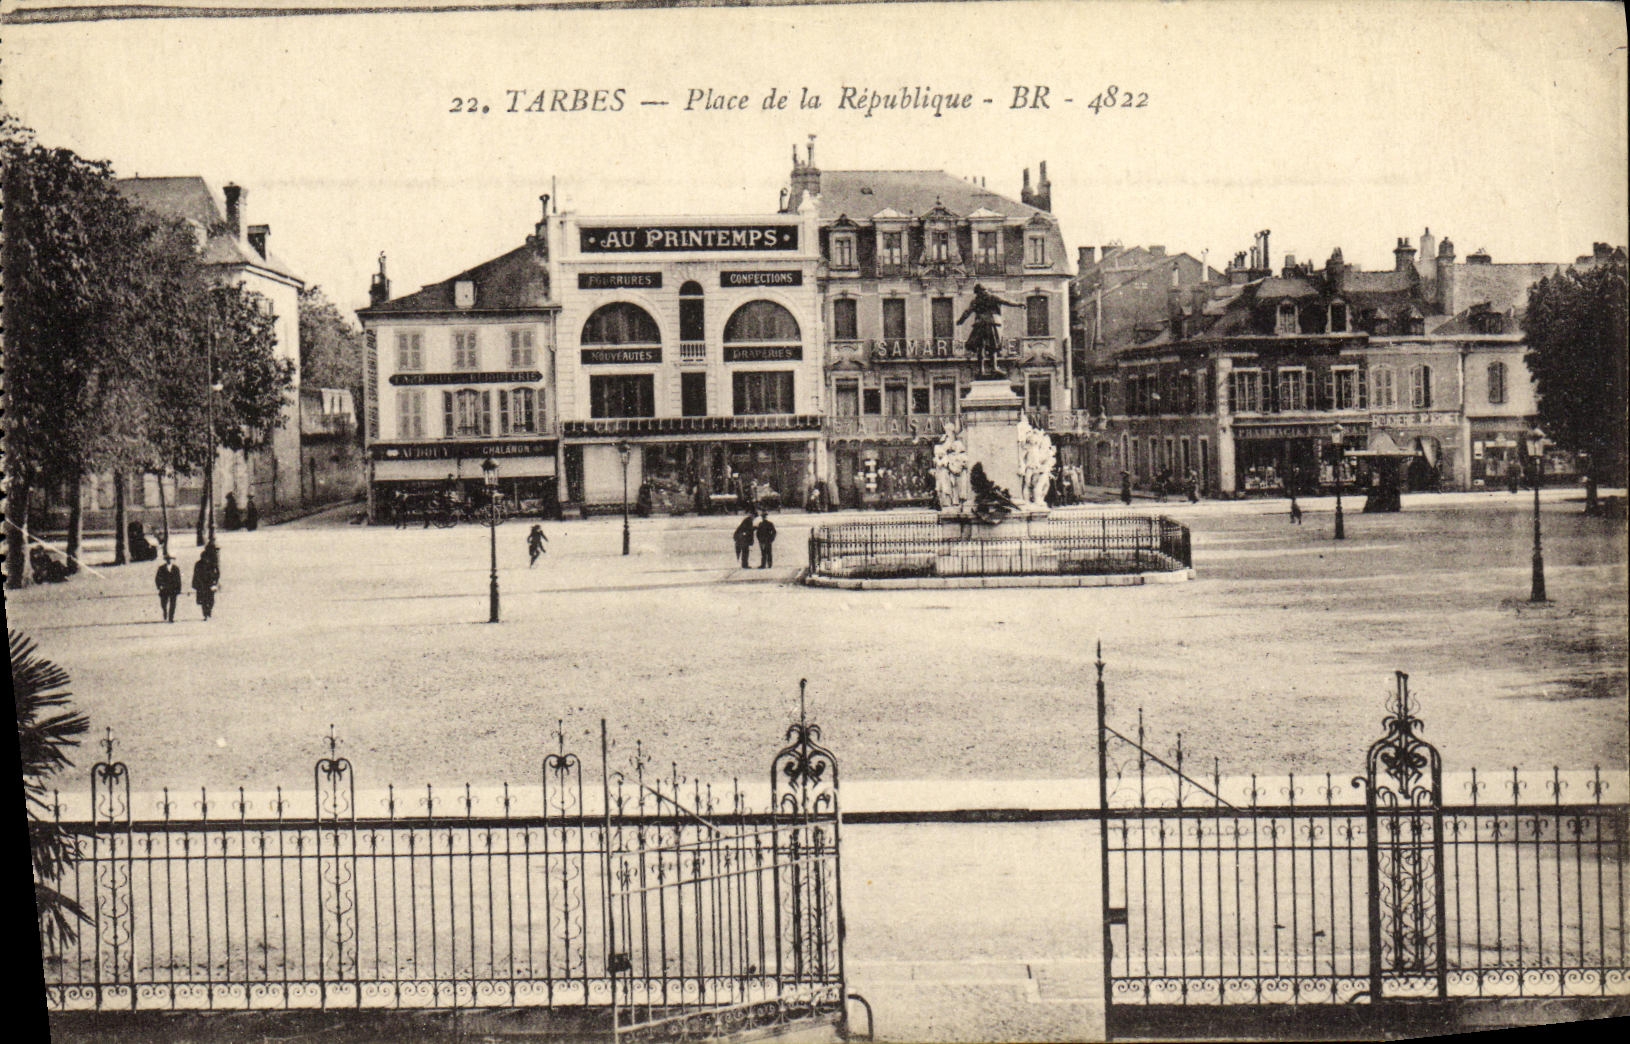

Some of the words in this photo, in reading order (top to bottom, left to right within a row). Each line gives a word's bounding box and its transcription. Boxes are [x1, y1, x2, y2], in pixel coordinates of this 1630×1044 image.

[600, 231, 636, 248] AU
[645, 229, 778, 248] PRINTEMPS
[587, 274, 652, 287] FOURRURES
[729, 273, 794, 285] CONFECTIONS
[732, 348, 793, 359] DRAPERIES
